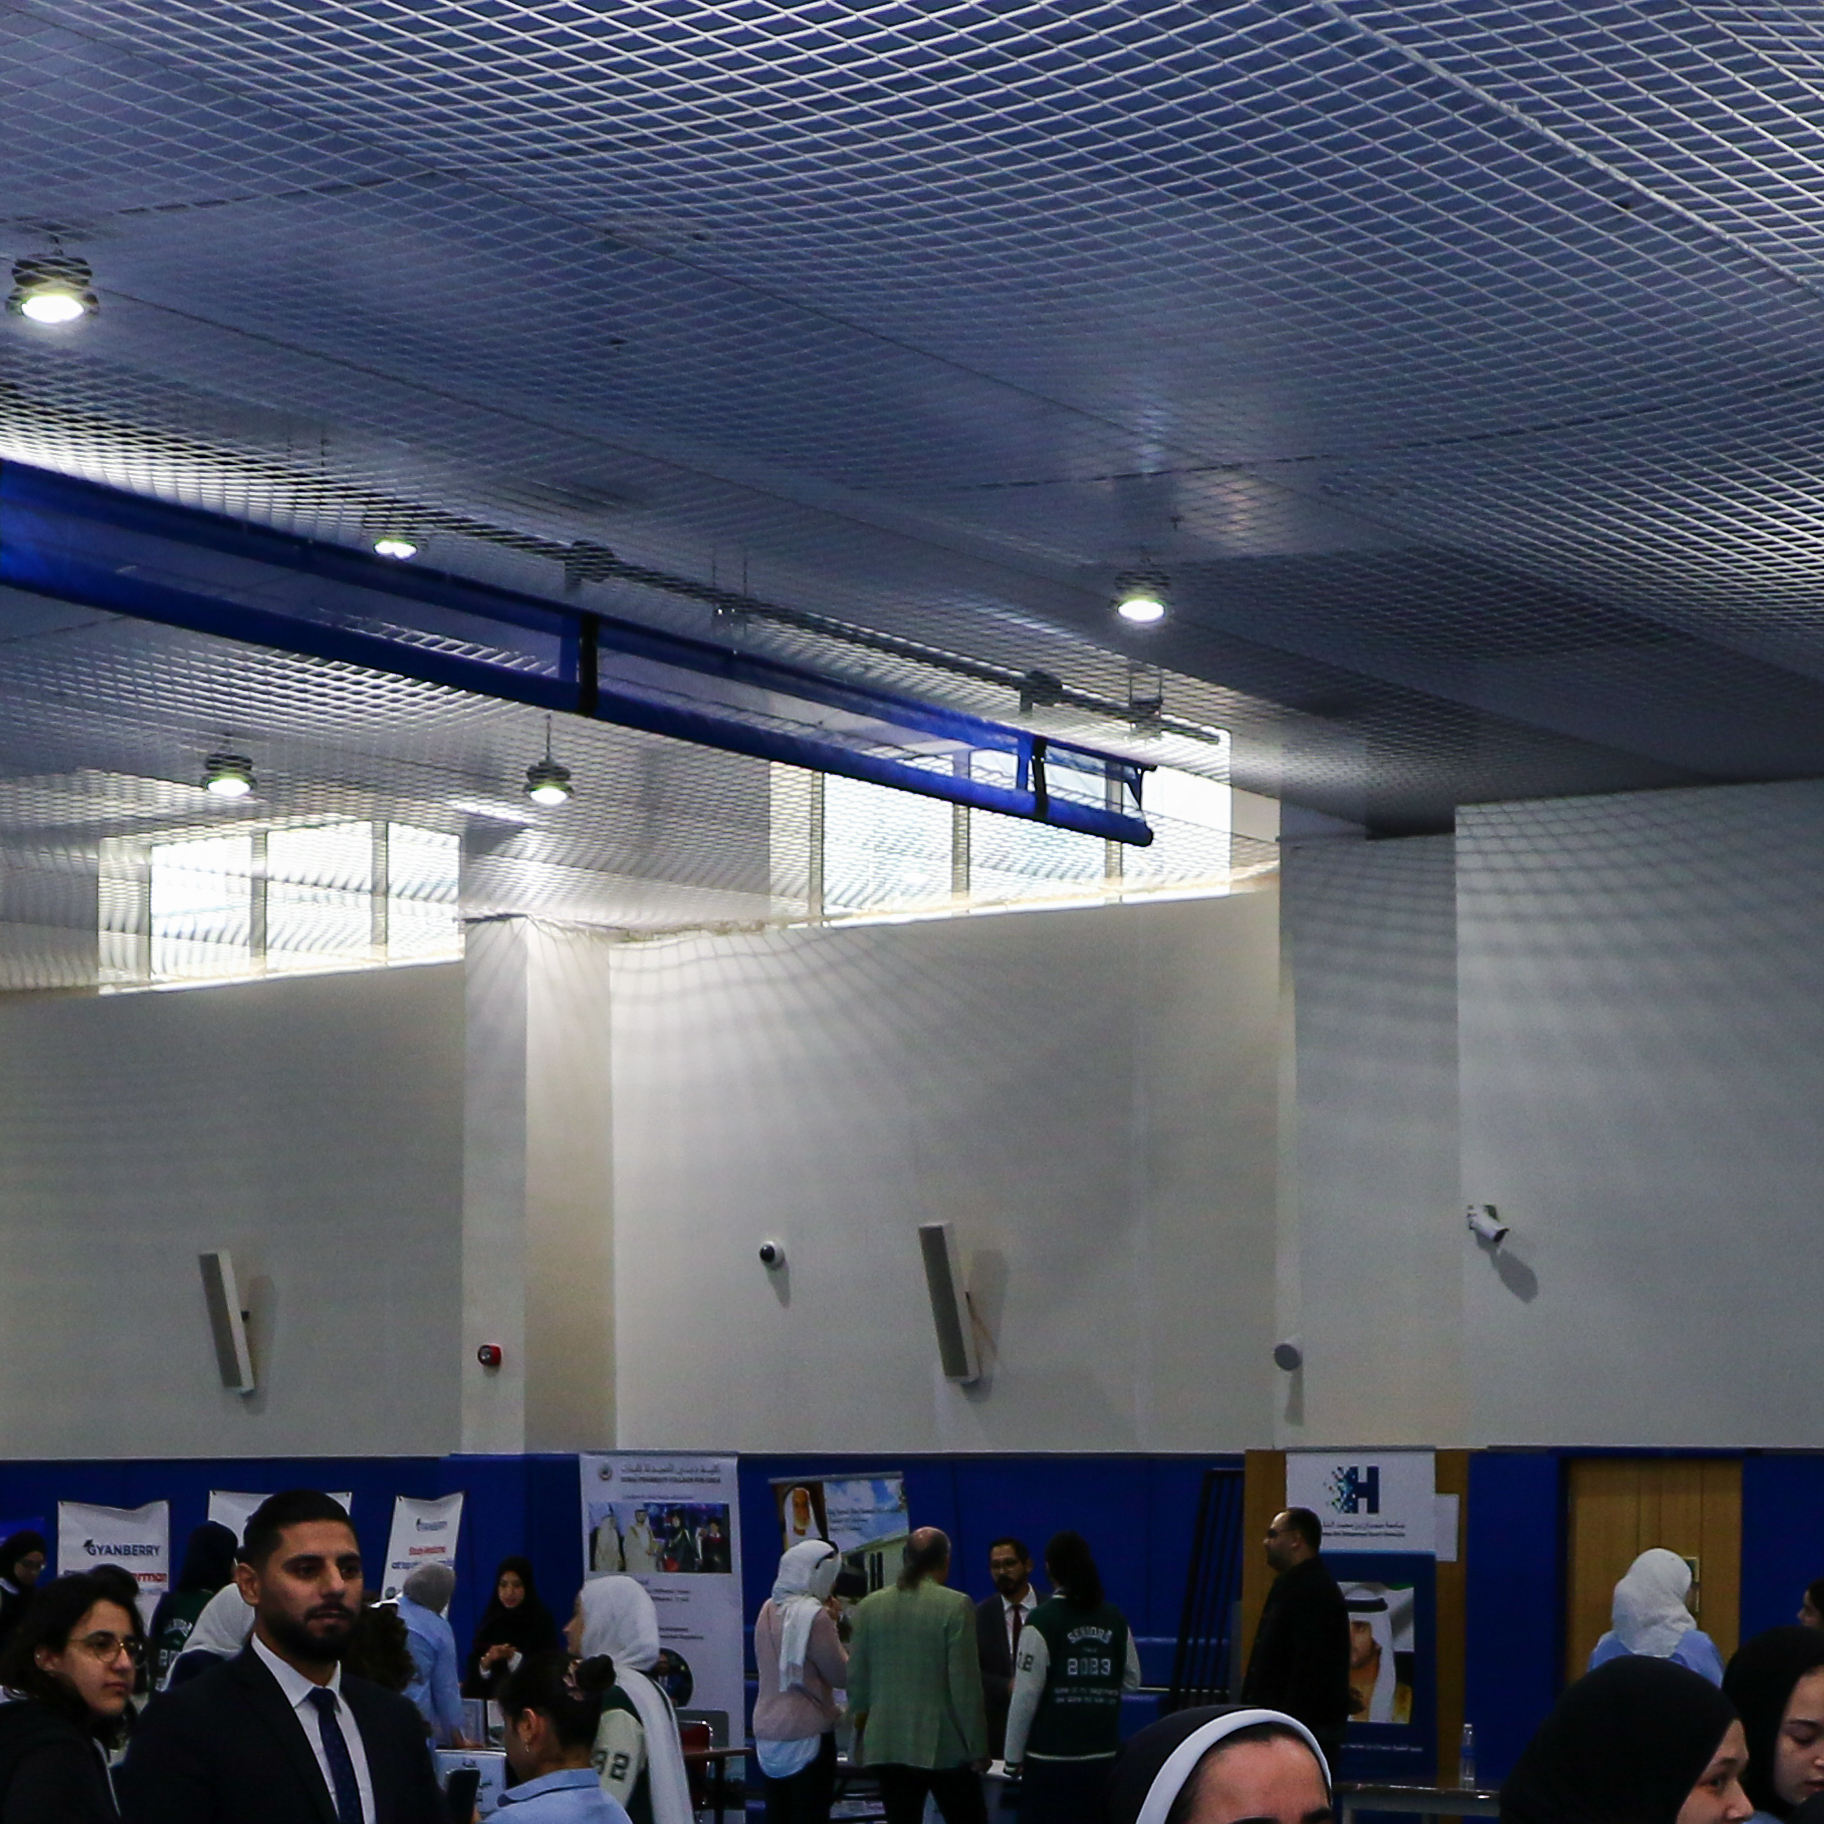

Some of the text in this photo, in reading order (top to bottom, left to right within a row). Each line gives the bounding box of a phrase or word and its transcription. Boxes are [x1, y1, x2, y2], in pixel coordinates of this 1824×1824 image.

[85, 1542, 160, 1556] GYANBERRY
[1066, 1625, 1114, 1645] SENIORS
[1066, 1657, 1112, 1676] 2023
